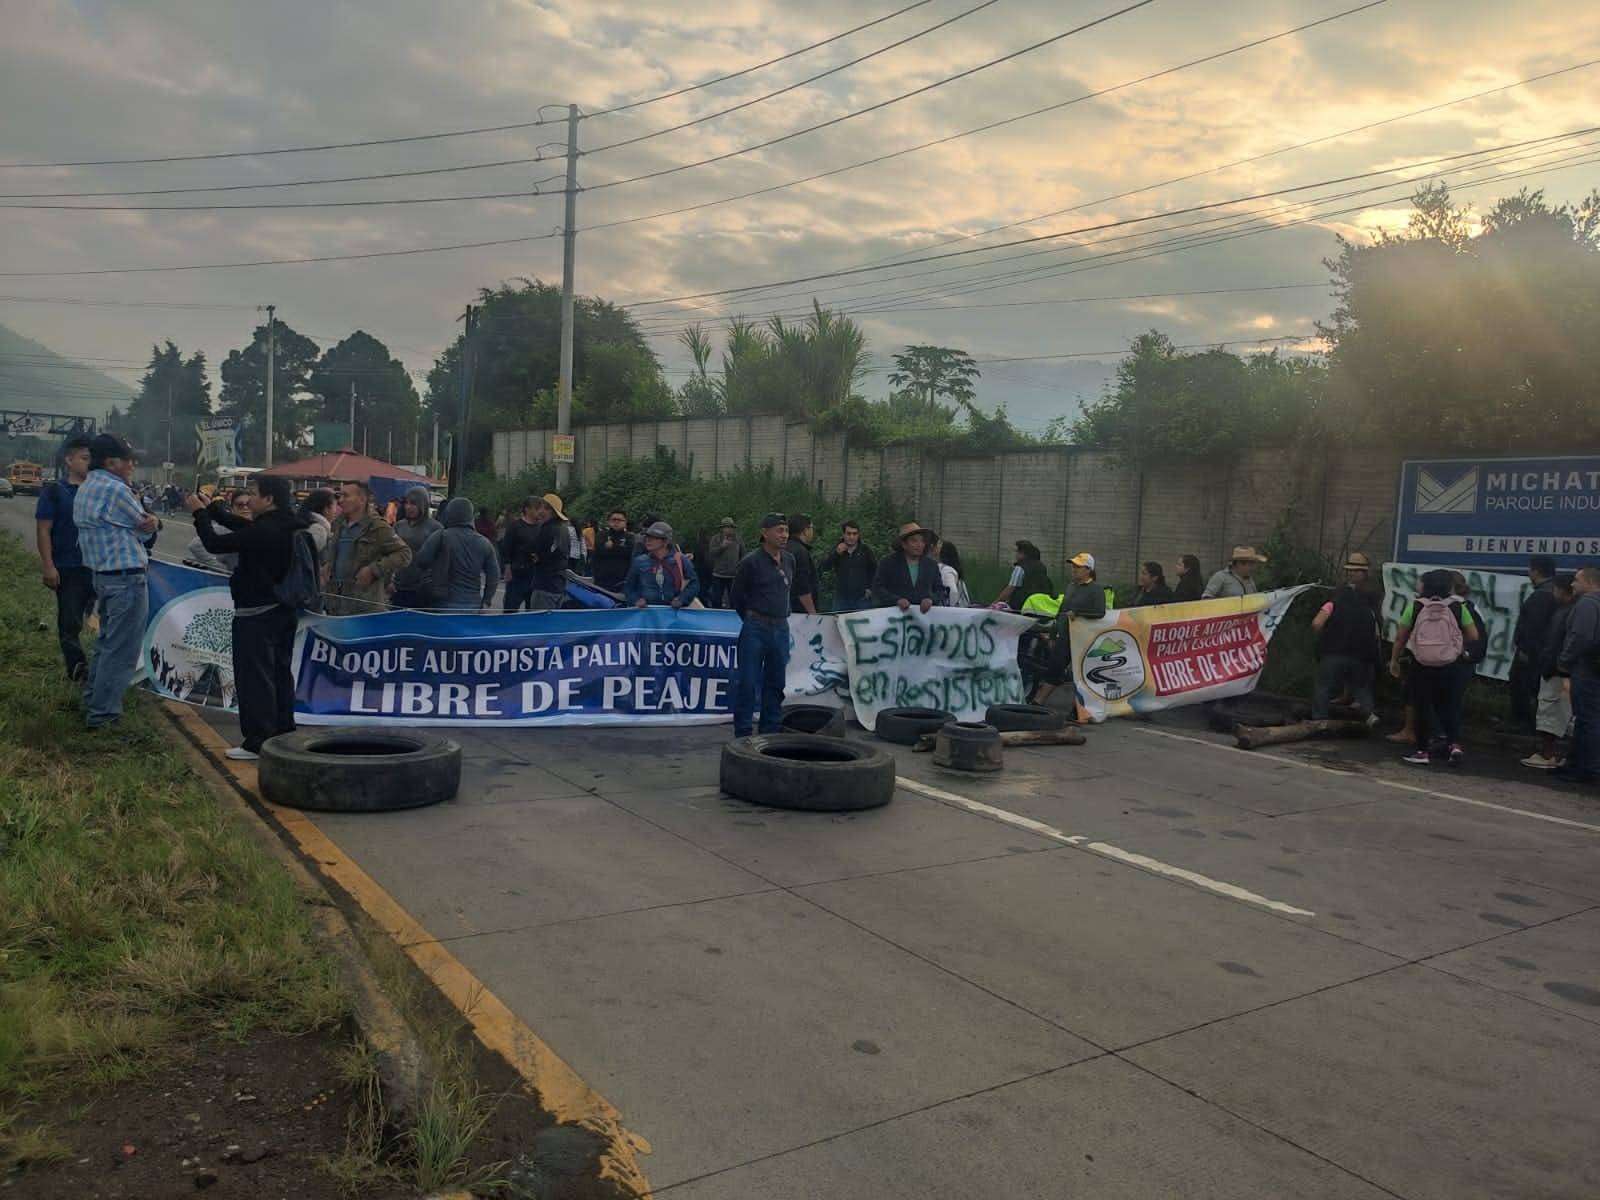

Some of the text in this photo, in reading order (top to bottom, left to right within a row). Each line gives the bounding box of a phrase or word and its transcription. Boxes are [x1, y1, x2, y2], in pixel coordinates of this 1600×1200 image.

[1487, 472, 1600, 490] MICHAT
[1486, 496, 1553, 511] PARQUE
[1466, 538, 1599, 554] BIENVENIDOS
[1153, 624, 1201, 642] BLOQUE
[310, 639, 415, 678] BLOQUE
[422, 646, 563, 674] AUTOPISTA
[572, 640, 642, 670] PALIN
[1153, 642, 1265, 691] LIBRE DE PEAJE
[349, 675, 730, 717] LIBRE DE PEAJE
[855, 671, 890, 705] en
